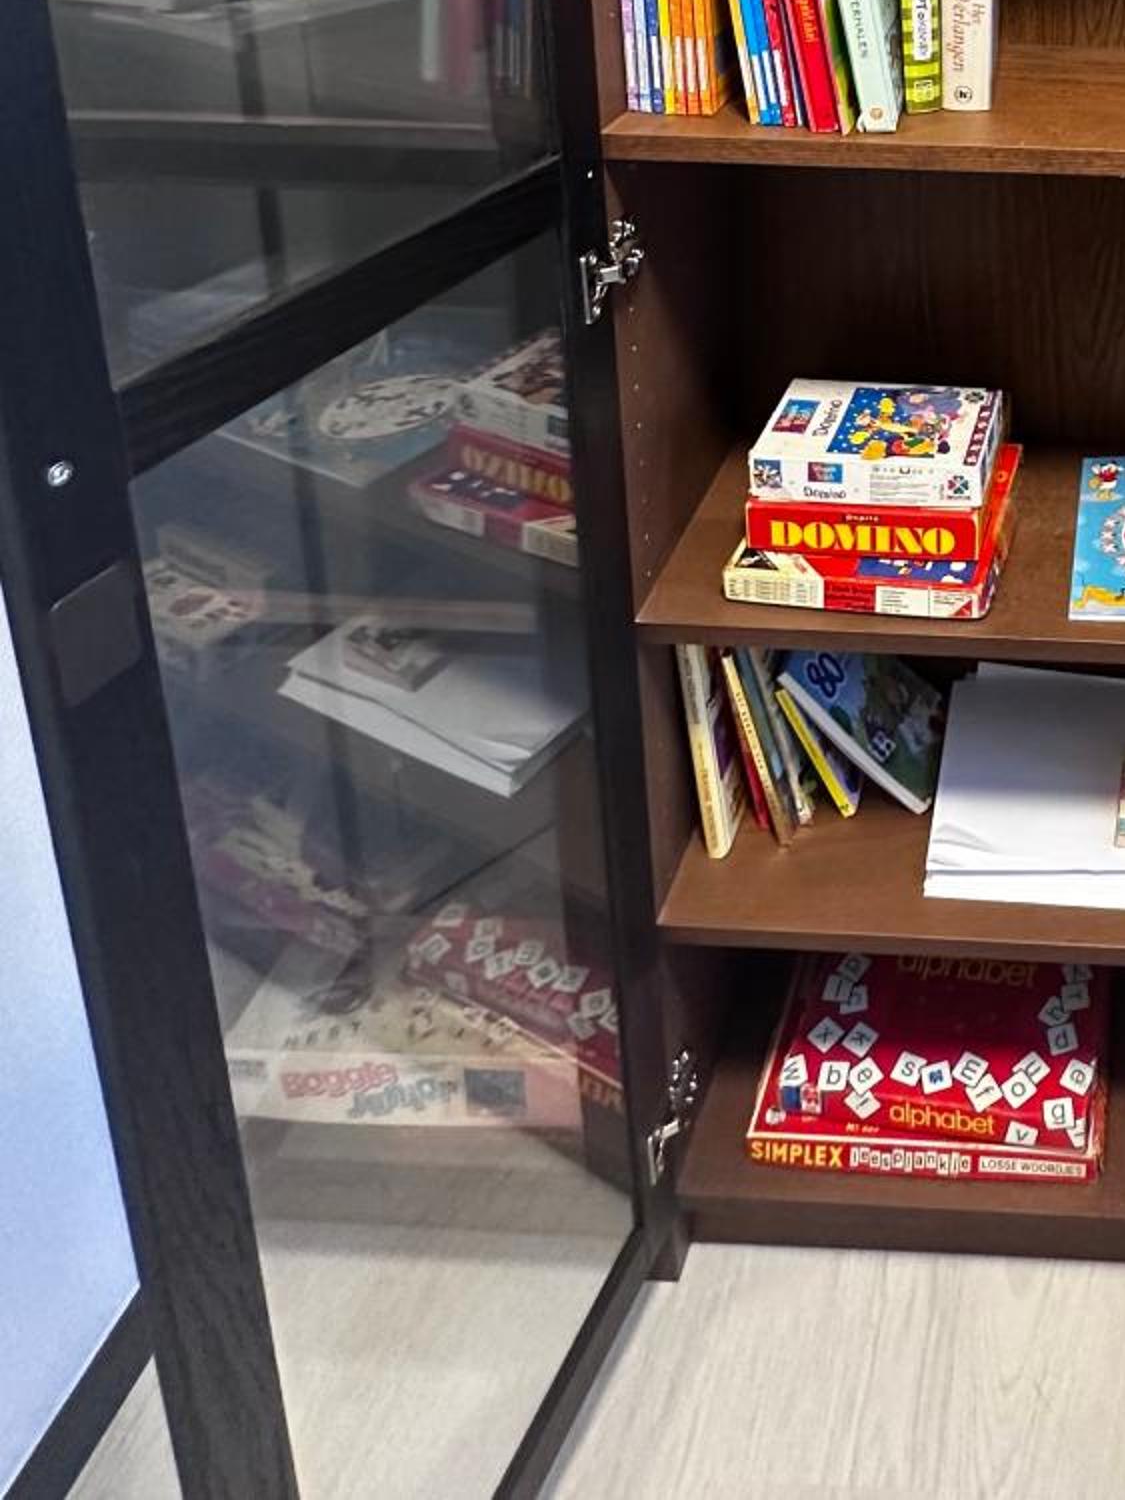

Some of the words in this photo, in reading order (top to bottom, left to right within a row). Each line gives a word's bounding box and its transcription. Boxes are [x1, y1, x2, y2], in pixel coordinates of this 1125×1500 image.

[769, 519, 956, 556] DOMINO
[826, 1065, 841, 1085] b
[1011, 1082, 1027, 1097] o
[888, 1100, 996, 1136] alphabet
[750, 1140, 843, 1169] SIMPLEX
